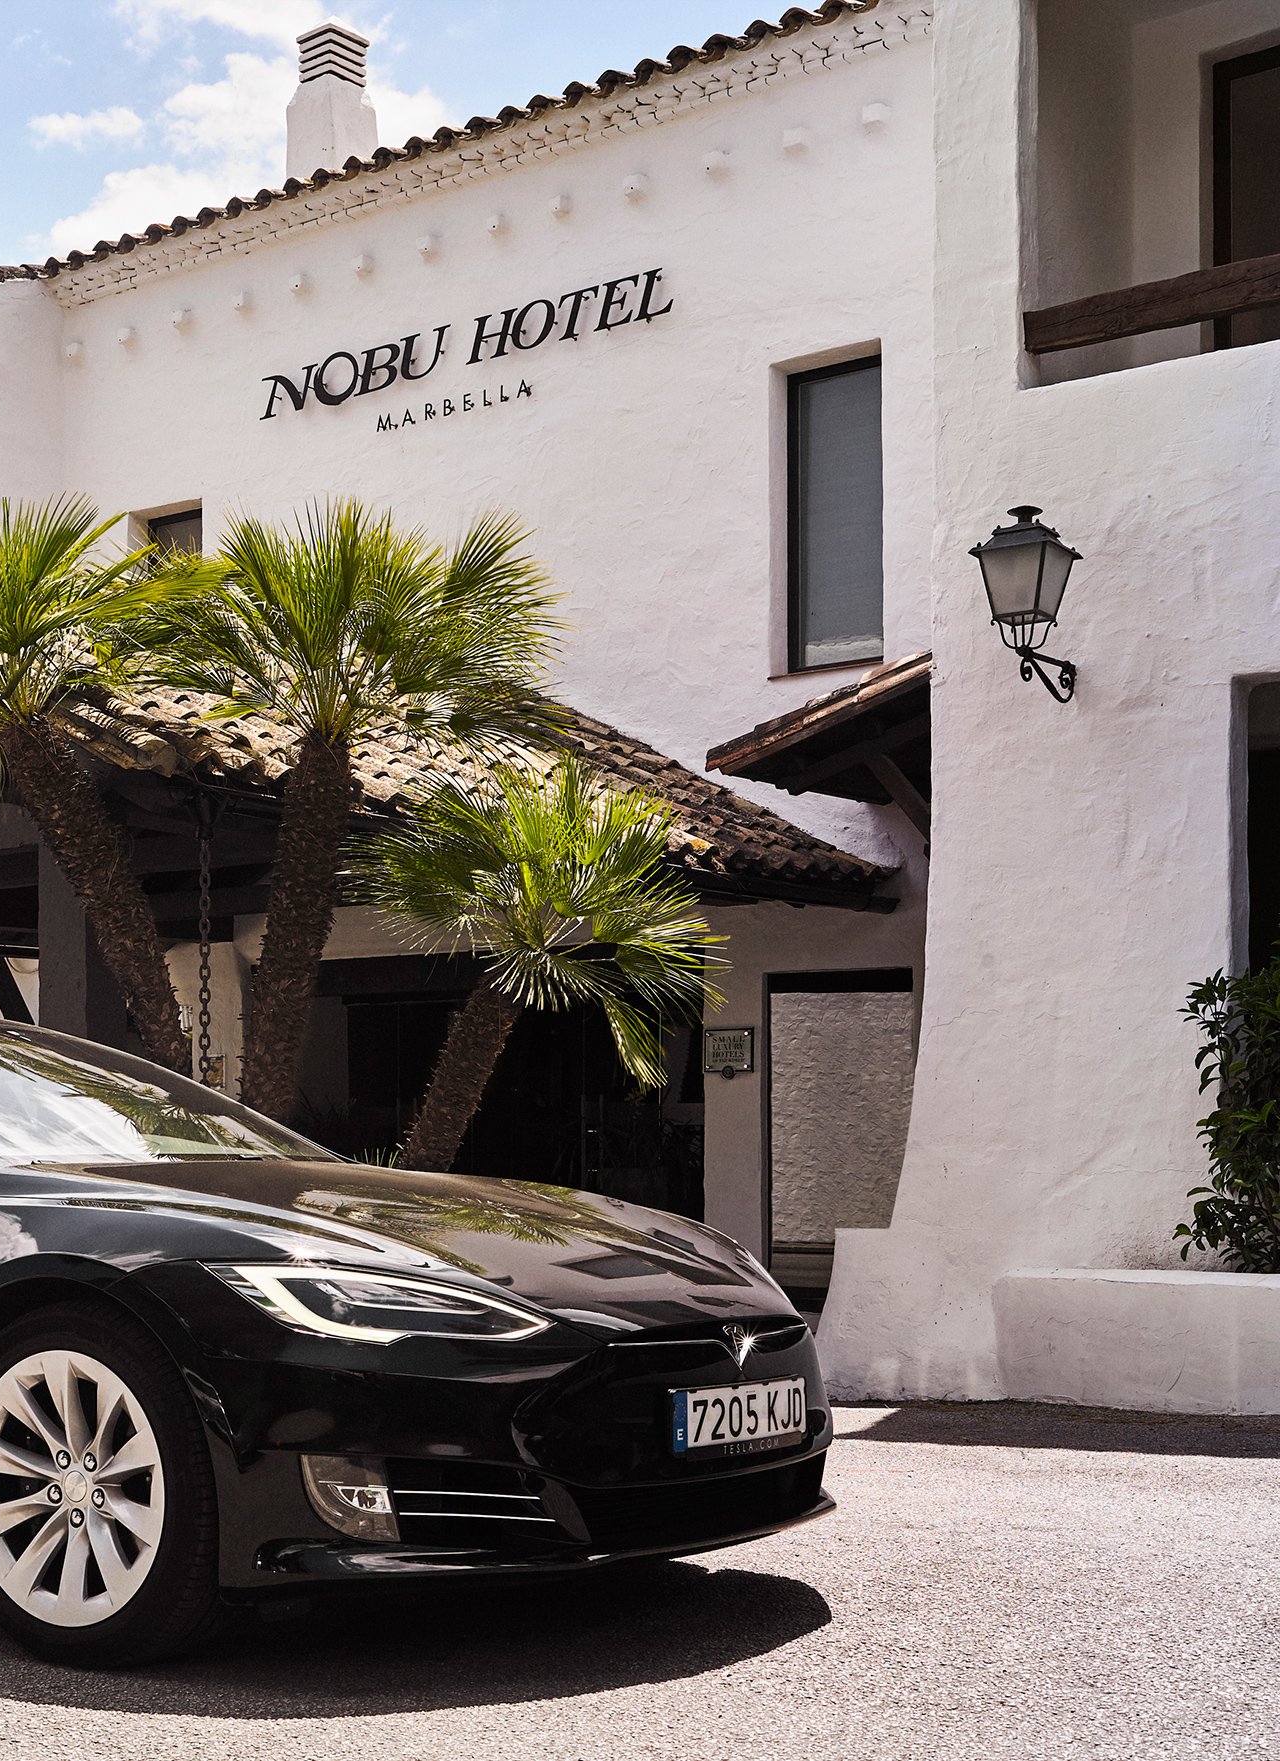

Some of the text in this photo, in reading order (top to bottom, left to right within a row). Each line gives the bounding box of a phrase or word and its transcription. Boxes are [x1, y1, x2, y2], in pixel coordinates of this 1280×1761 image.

[259, 267, 674, 421] NOBU HOTEL
[376, 379, 531, 432] MARBELLA
[712, 1050, 745, 1058] HOTELS
[692, 1387, 802, 1443] 7205 KJD
[677, 1428, 684, 1441] E
[723, 1437, 780, 1455] TESLA.COM
